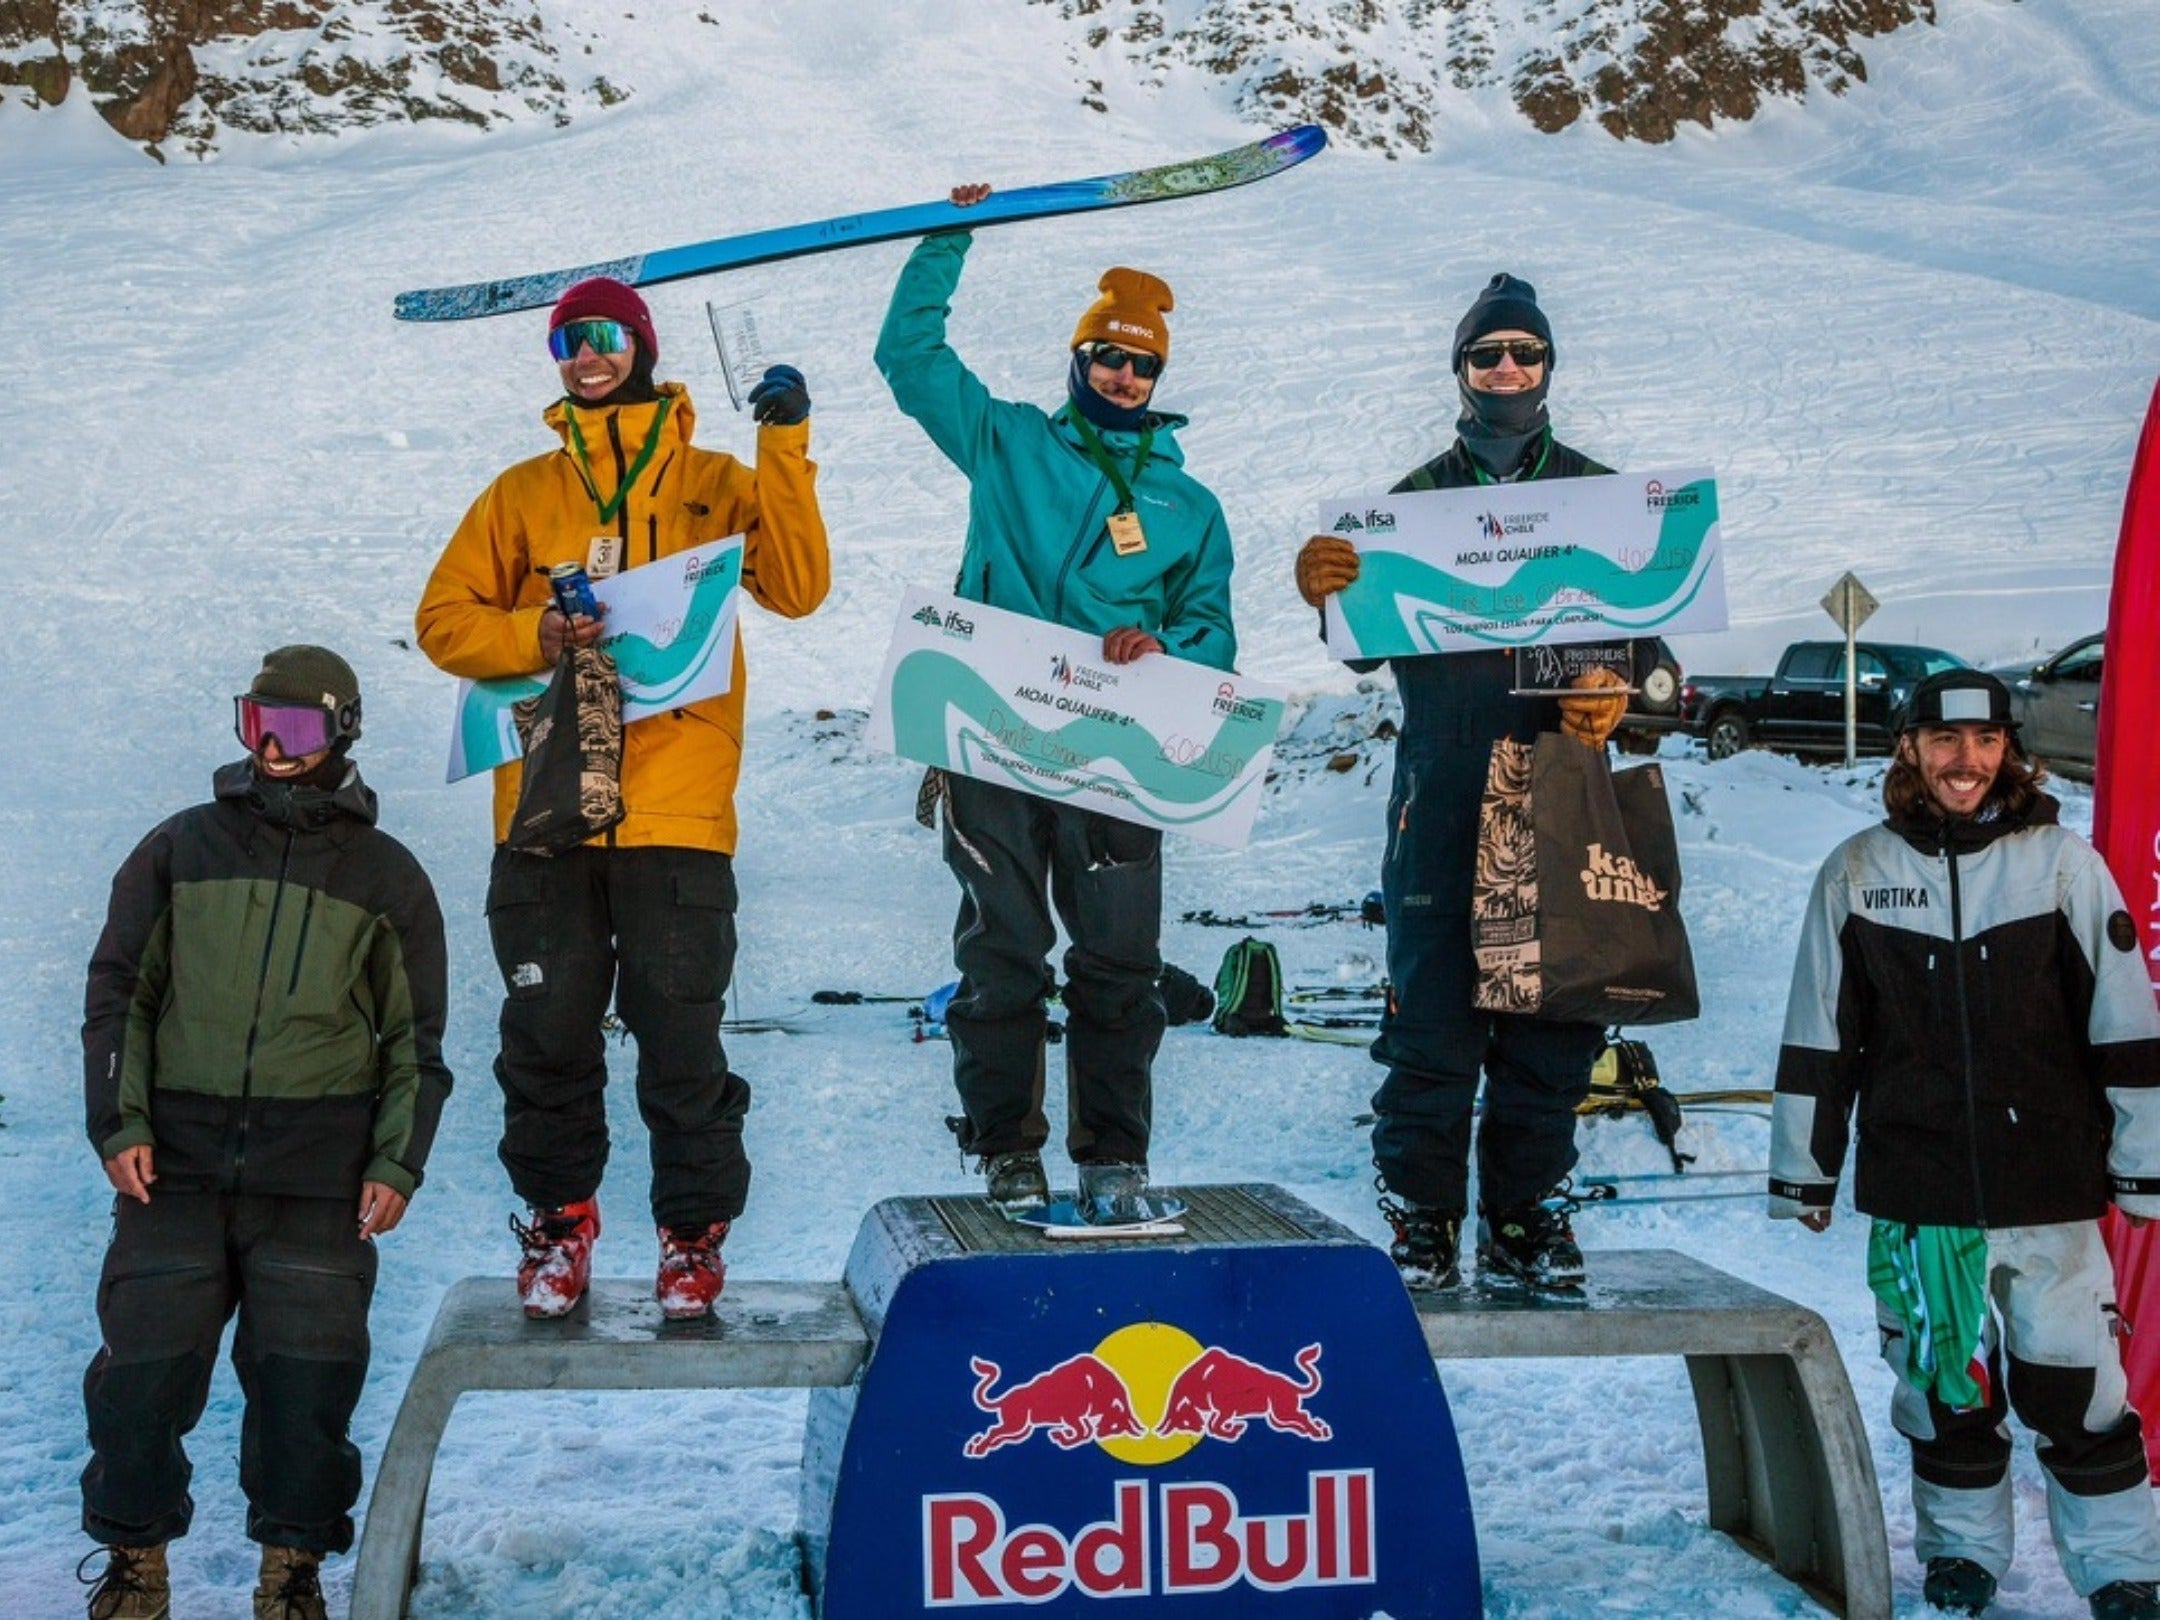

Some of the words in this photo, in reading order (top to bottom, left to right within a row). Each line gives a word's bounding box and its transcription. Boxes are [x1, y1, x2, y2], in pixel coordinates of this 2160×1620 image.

[1365, 509, 1396, 528] ifsa
[1454, 551, 1494, 566] MOAI
[944, 610, 975, 634] ifsa
[1014, 685, 1054, 706] MOAI
[1862, 887, 1929, 910] VIRTIKA
[929, 1484, 1144, 1601] Red
[1165, 1473, 1371, 1587] Bull
